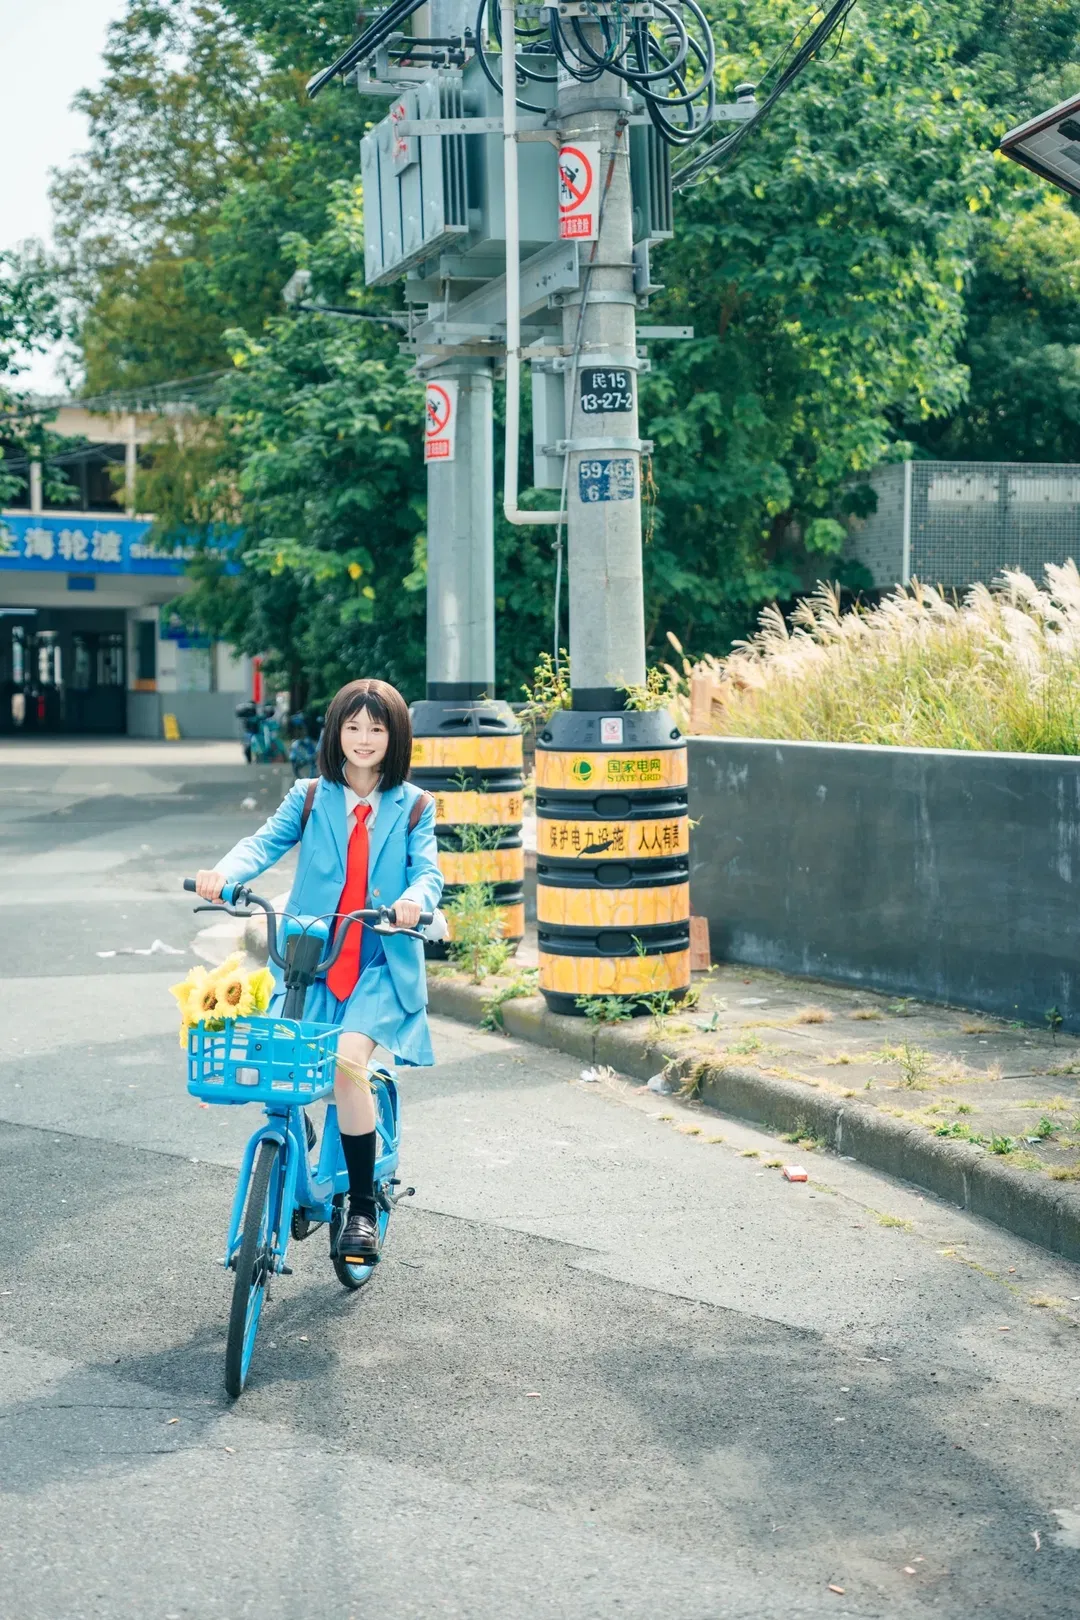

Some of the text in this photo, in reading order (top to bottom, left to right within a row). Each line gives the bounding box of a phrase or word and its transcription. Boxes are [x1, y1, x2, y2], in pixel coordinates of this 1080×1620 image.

[581, 392, 633, 410] 13-27-2
[608, 759, 661, 773] 国家电网
[550, 825, 679, 851] 保护电力设施 人人有责
